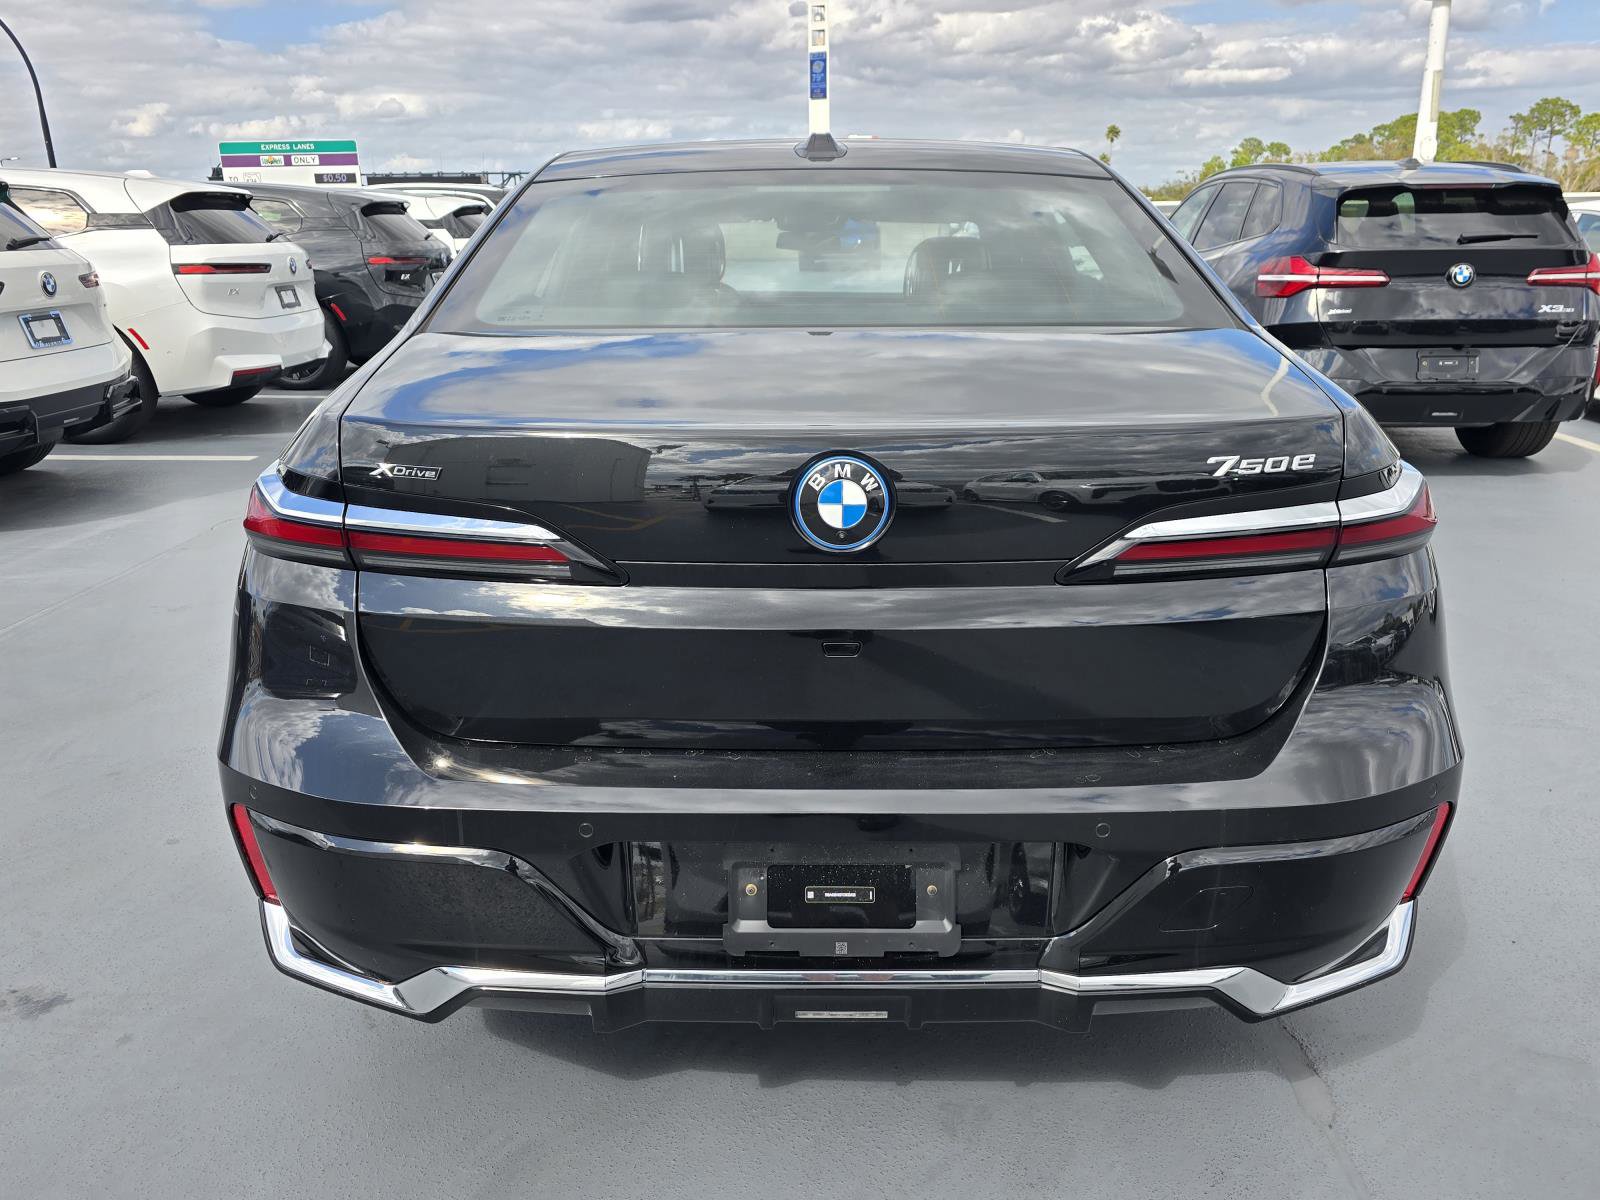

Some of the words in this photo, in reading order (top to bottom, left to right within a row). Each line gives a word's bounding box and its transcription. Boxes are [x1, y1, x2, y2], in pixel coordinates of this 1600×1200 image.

[260, 143, 290, 151] EXPRESS
[293, 156, 316, 164] ONLY
[322, 173, 347, 182] $0.50
[1206, 453, 1316, 477] 750e
[807, 463, 879, 492] BMW
